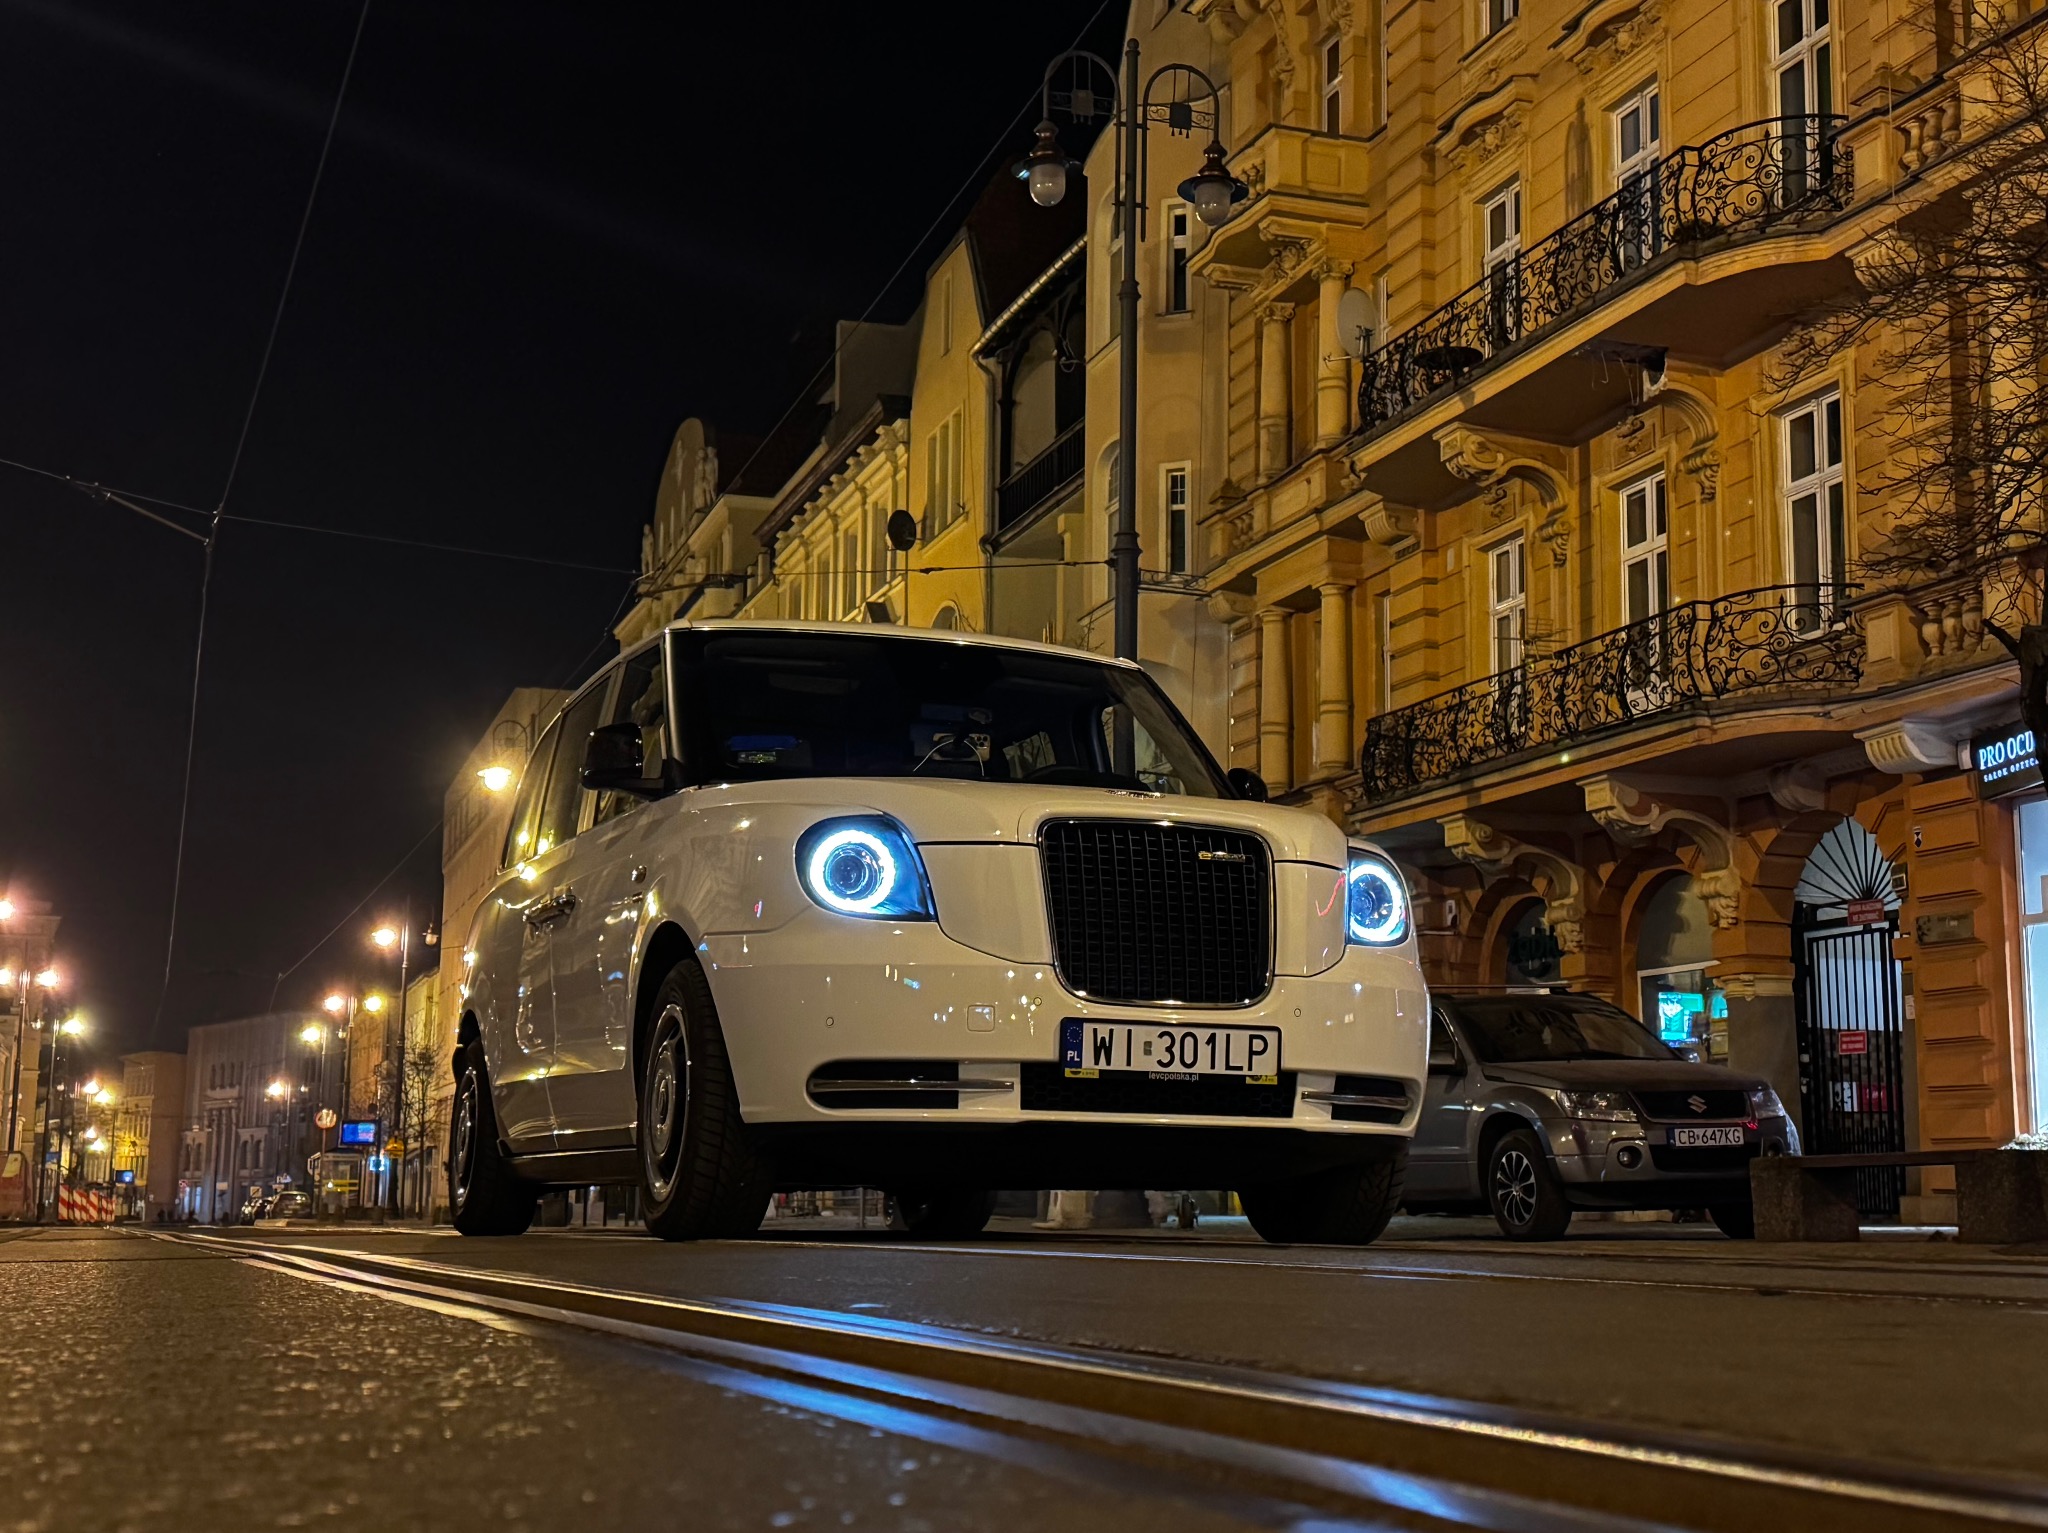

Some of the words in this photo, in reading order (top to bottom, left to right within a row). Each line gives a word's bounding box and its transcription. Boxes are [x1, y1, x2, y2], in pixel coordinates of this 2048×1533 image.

[1979, 741, 2005, 770] PRO
[2006, 730, 2034, 759] OCU
[1983, 767, 2009, 783] SALON
[1066, 1050, 1081, 1062] PL
[1092, 1027, 1132, 1067] WI
[1156, 1030, 1269, 1072] 301LP
[1148, 1070, 1199, 1083] levcpolska.pl
[1678, 1129, 1695, 1145] CB
[1701, 1128, 1741, 1145] 647KG
